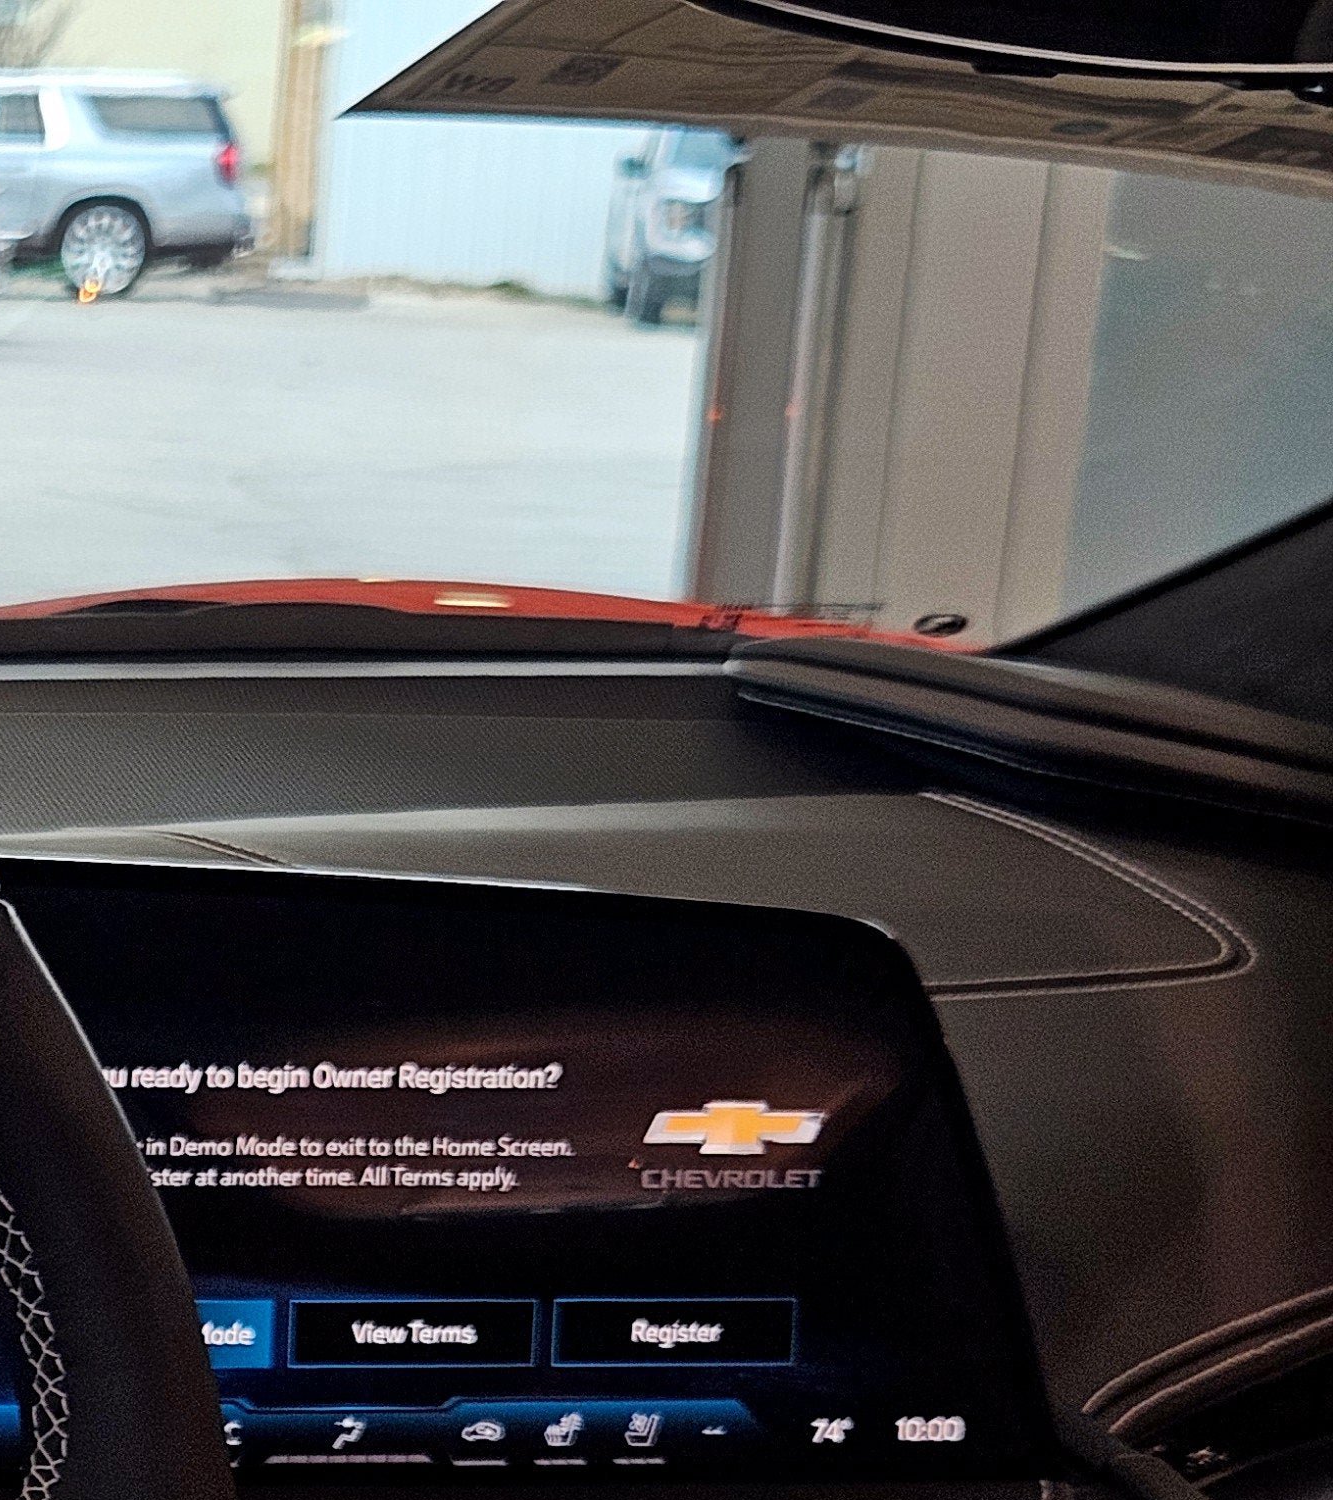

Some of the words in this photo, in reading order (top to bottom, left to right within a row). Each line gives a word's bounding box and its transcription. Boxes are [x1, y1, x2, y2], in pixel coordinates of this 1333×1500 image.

[132, 1061, 204, 1094] ready
[206, 1064, 234, 1089] to
[237, 1061, 310, 1094] begin
[313, 1061, 396, 1089] Owner
[399, 1061, 562, 1095] Registration?
[146, 1136, 167, 1156] in
[170, 1136, 234, 1157] Demo
[236, 1135, 298, 1157] Mode
[300, 1138, 325, 1157] to
[326, 1136, 367, 1157] exit
[367, 1138, 393, 1157] to
[394, 1135, 432, 1157] the
[433, 1136, 497, 1157] Home
[497, 1136, 577, 1157] Screen.
[148, 1167, 192, 1188] ster
[194, 1168, 218, 1188] at
[219, 1166, 305, 1188] another
[306, 1166, 358, 1188] time.
[359, 1165, 389, 1188] All
[390, 1166, 453, 1188] Terms
[456, 1166, 521, 1192] apply.
[641, 1169, 824, 1188] CHEVROLET
[351, 1320, 407, 1345] View
[409, 1321, 479, 1345] Terms
[631, 1319, 724, 1348] Register
[895, 1413, 968, 1443] 10:00
